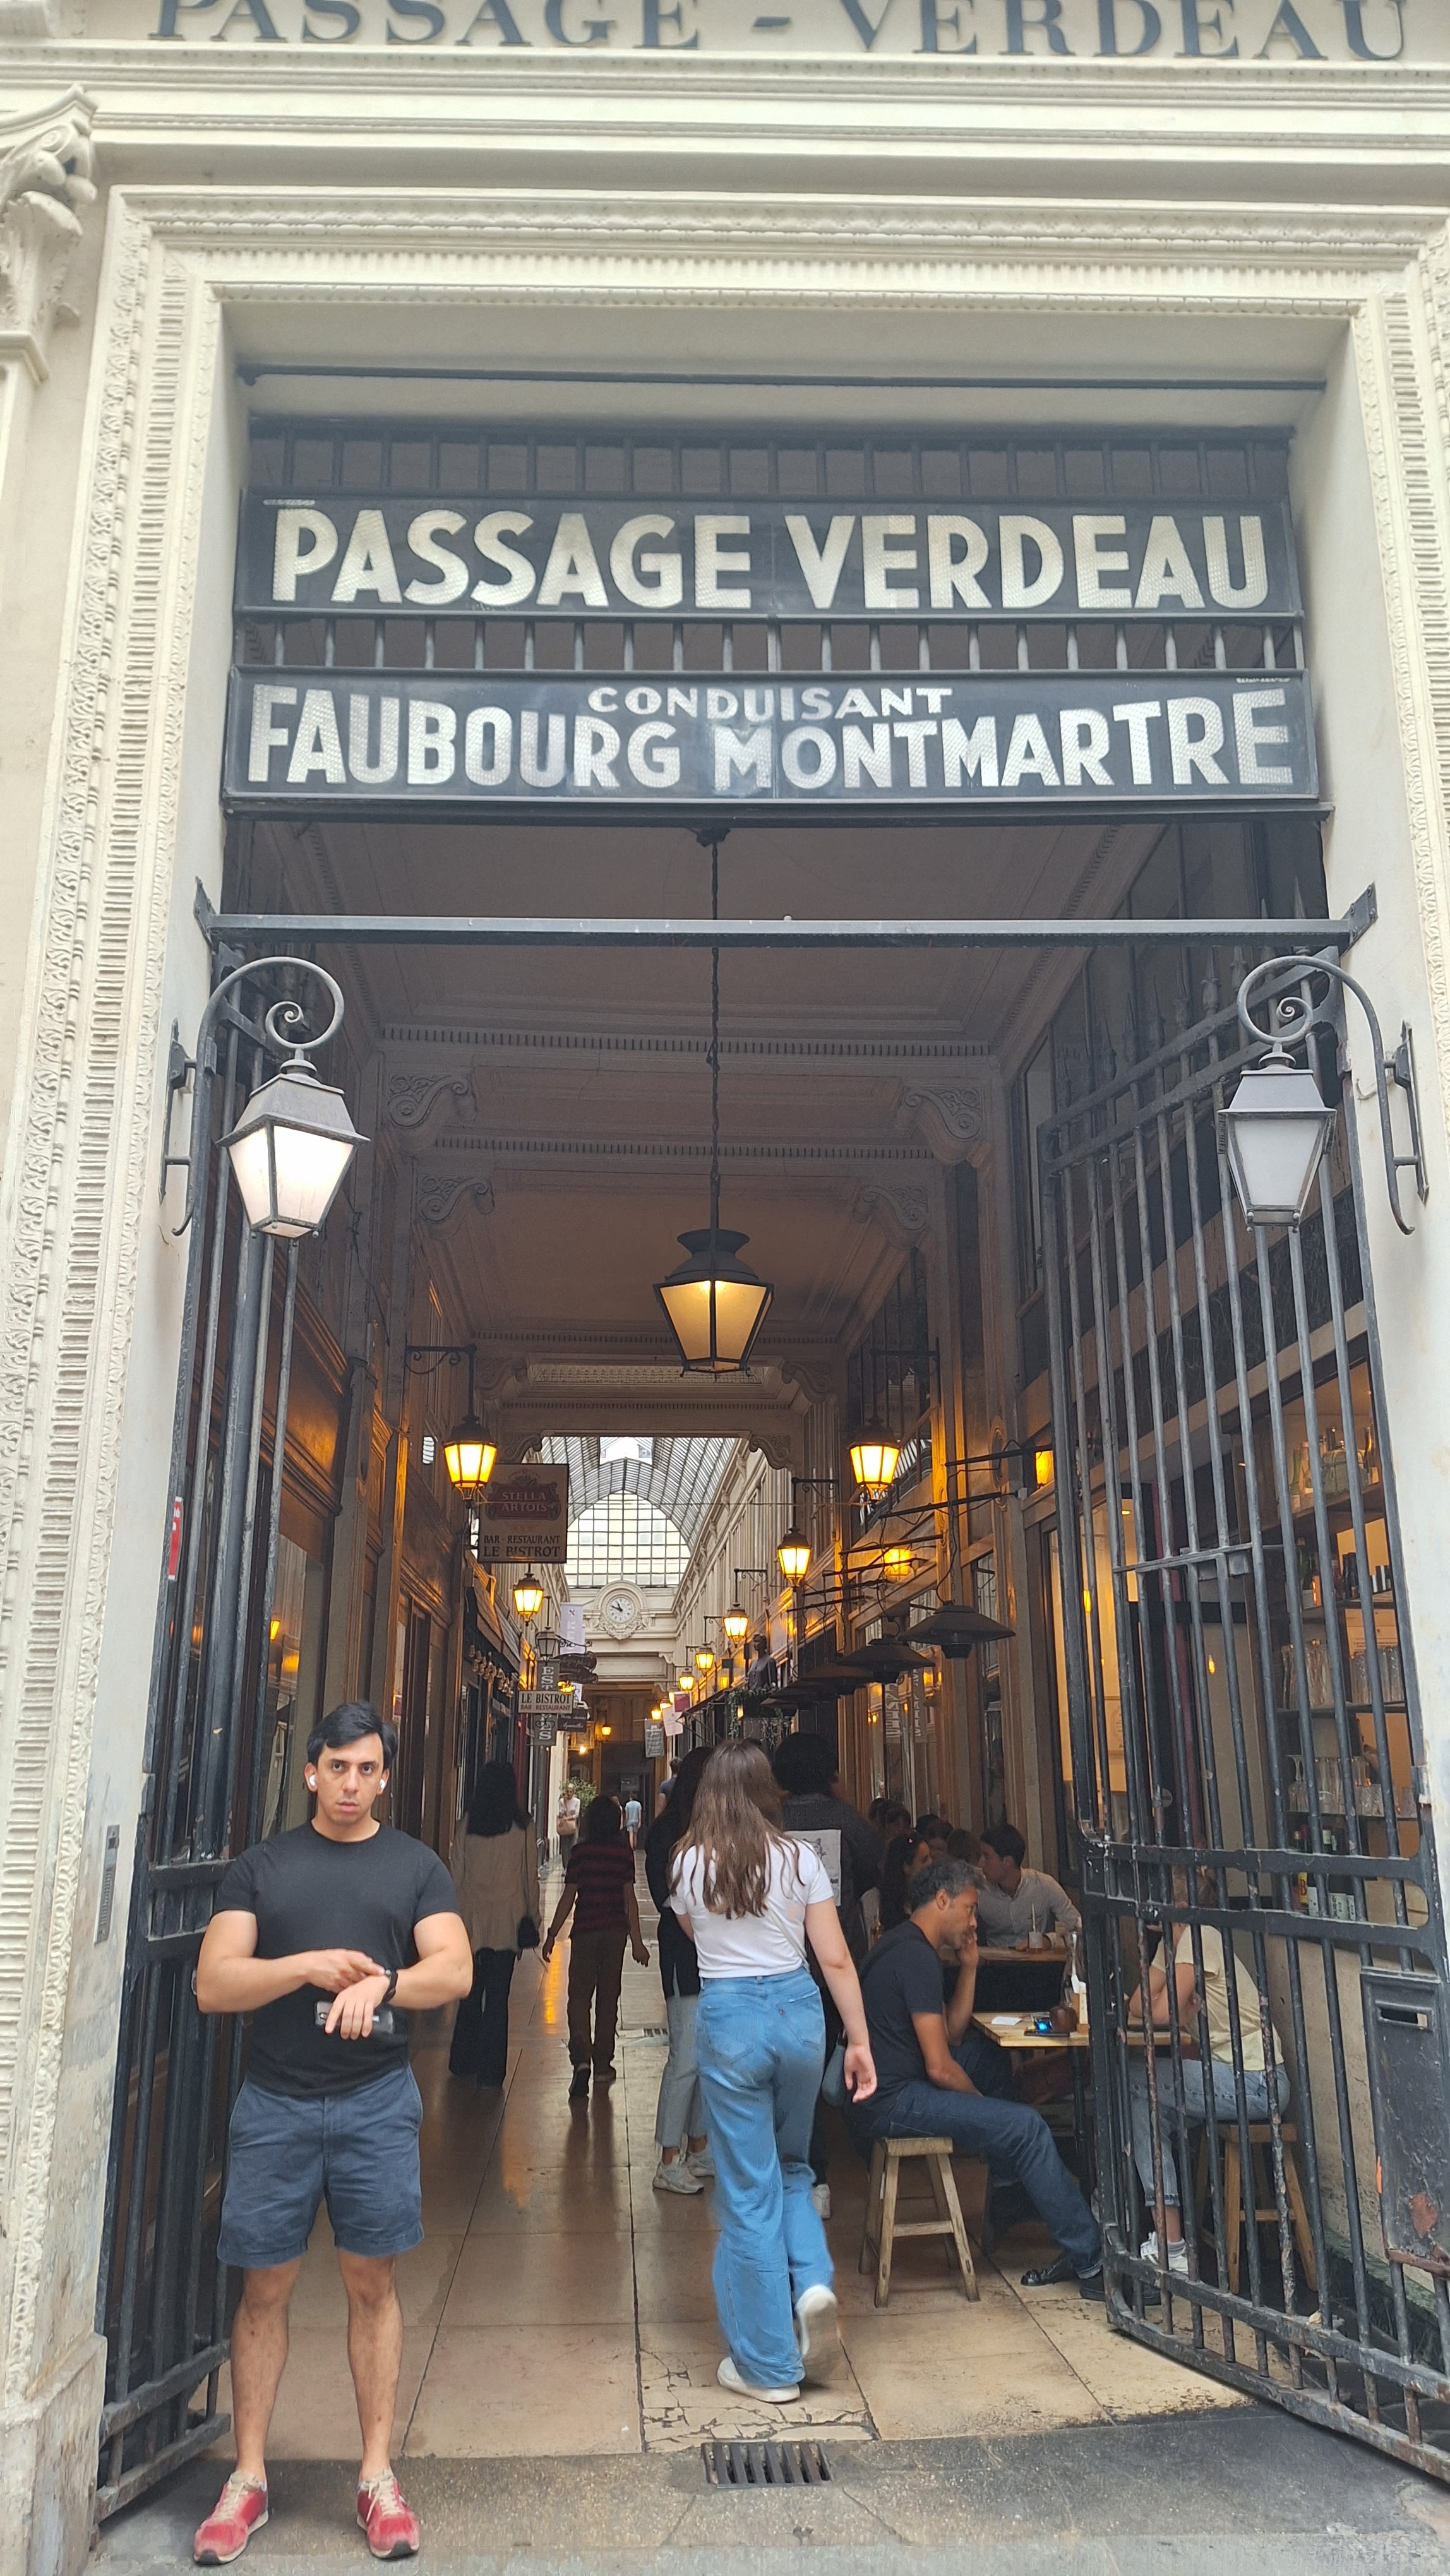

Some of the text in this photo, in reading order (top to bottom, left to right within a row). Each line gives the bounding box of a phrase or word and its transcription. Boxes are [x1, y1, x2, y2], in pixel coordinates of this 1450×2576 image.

[840, 0, 1406, 61] VERDEAU
[273, 509, 1268, 609] PASSAGE VERDEAU
[588, 686, 953, 721] CONDUISANT
[248, 684, 1293, 790] FAUBOURG MONTMARTRE
[502, 1492, 546, 1501] STELLA
[501, 1503, 548, 1512] ARTOIS
[484, 1535, 500, 1544] BAR
[507, 1535, 561, 1544] RESTAURANT
[483, 1546, 560, 1557] LE BISTROT
[521, 1693, 570, 1704] LE BISTROT
